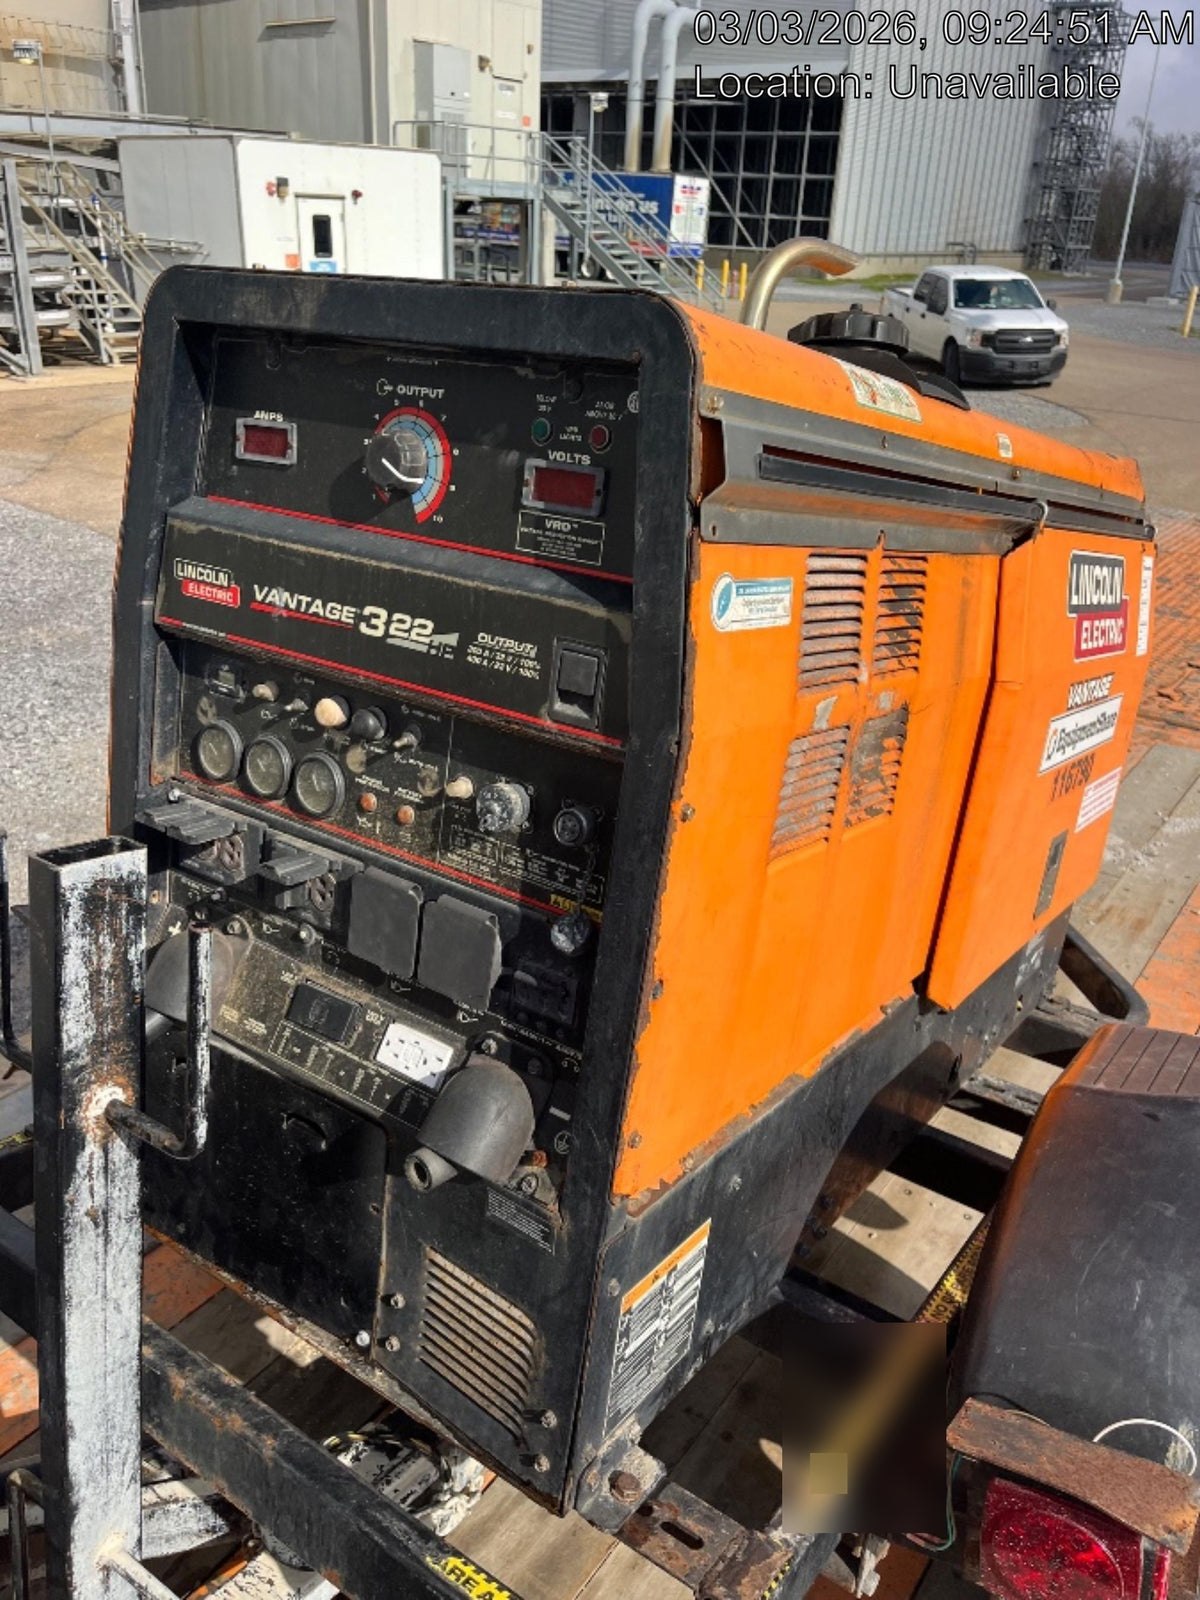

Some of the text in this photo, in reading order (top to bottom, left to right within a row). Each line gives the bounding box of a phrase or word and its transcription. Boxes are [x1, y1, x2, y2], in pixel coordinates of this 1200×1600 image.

[396, 384, 445, 399] OUTPUT
[548, 449, 592, 466] VOLTS
[177, 562, 230, 588] LINCOLN
[1070, 563, 1123, 606] LINCOLN
[188, 582, 234, 603] ELECTRIC
[253, 584, 435, 645] VANTAGE 322
[1081, 617, 1124, 650] ELECTRIC
